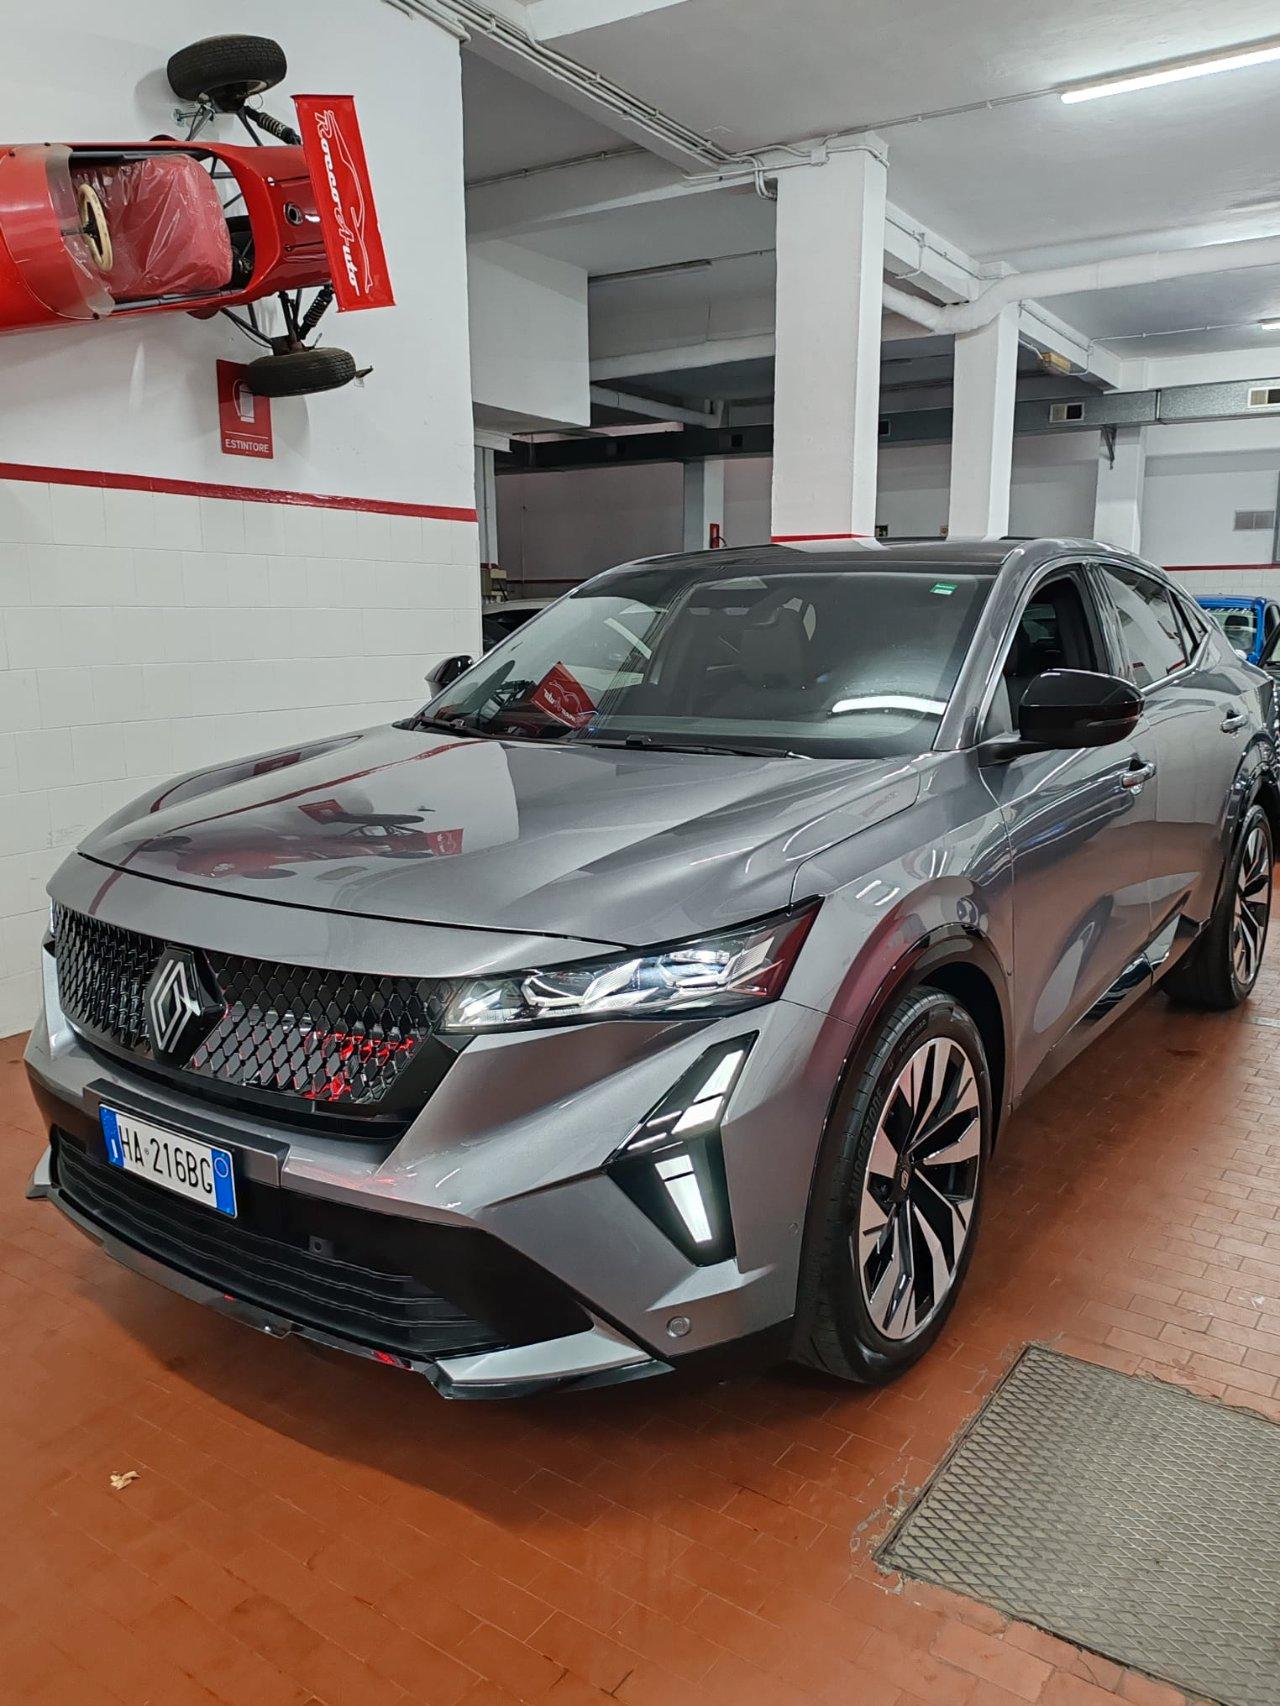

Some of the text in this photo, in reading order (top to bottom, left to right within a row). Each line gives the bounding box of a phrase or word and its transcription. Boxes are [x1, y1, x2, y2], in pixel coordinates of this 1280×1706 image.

[225, 438, 270, 453] ESTINTORE
[118, 1125, 144, 1167] HA
[150, 1138, 213, 1194] 216BG
